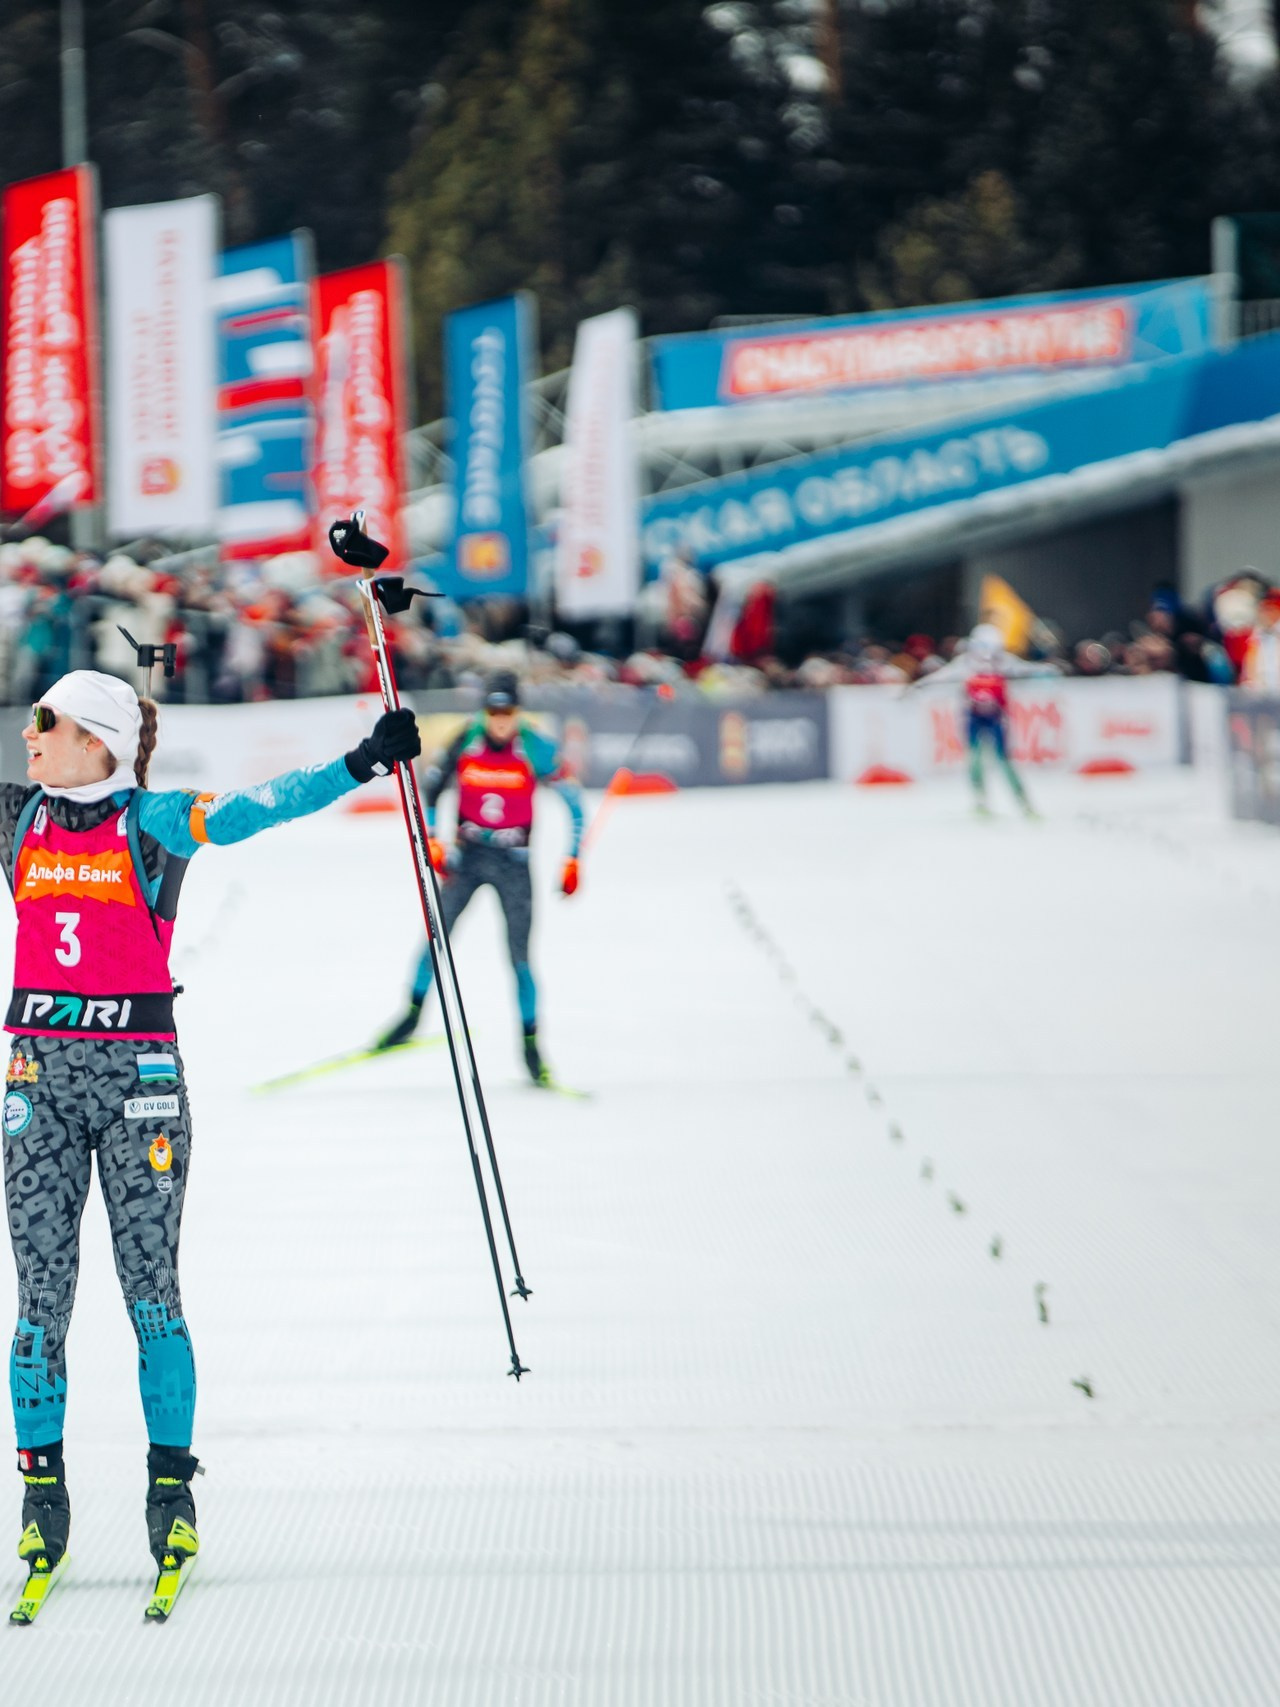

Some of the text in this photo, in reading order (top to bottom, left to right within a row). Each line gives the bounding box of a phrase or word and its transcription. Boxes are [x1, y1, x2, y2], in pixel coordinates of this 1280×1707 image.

[26, 862, 122, 886] Альфа Банк
[54, 911, 82, 968] 3
[21, 993, 132, 1029] PARI
[144, 1101, 175, 1111] GV GOLD
